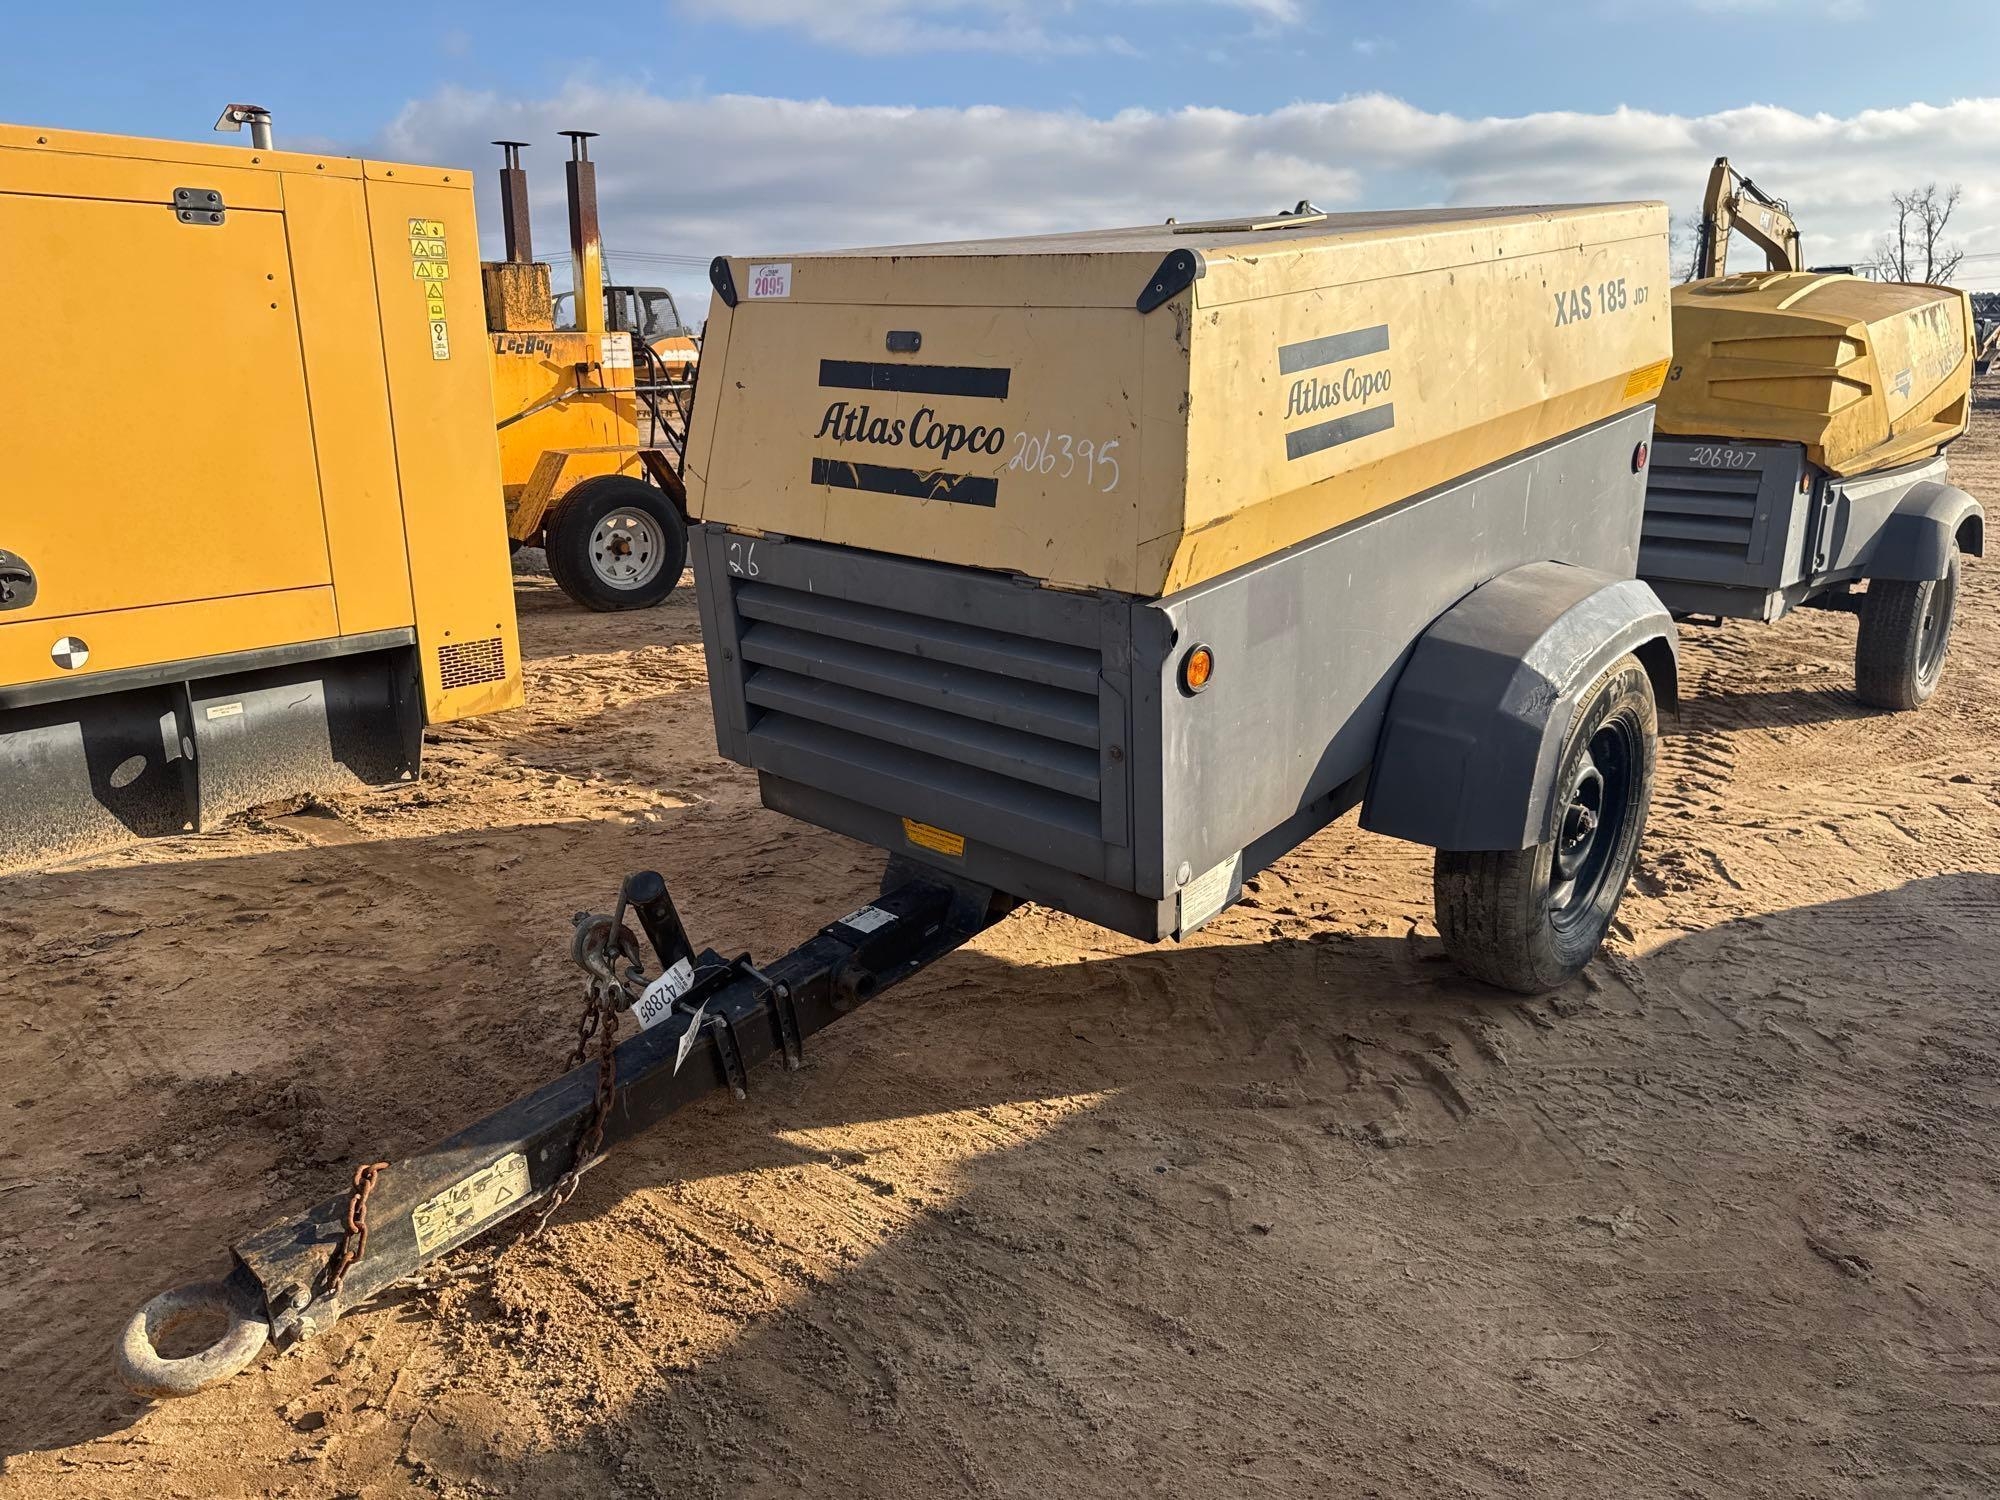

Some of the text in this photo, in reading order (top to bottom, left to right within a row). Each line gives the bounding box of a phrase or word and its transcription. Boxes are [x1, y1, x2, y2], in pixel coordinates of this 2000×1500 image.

[755, 276, 784, 297] 2095
[1553, 277, 1649, 328] XAS 185 JD7
[1284, 367, 1392, 420] Atlas Copco
[1670, 365, 1683, 381] 3
[813, 401, 1005, 460] Atlas Copco
[1008, 429, 1120, 493] 206395
[1688, 446, 1757, 470] 206907
[728, 541, 760, 576] 26
[640, 983, 678, 1024] 42885
